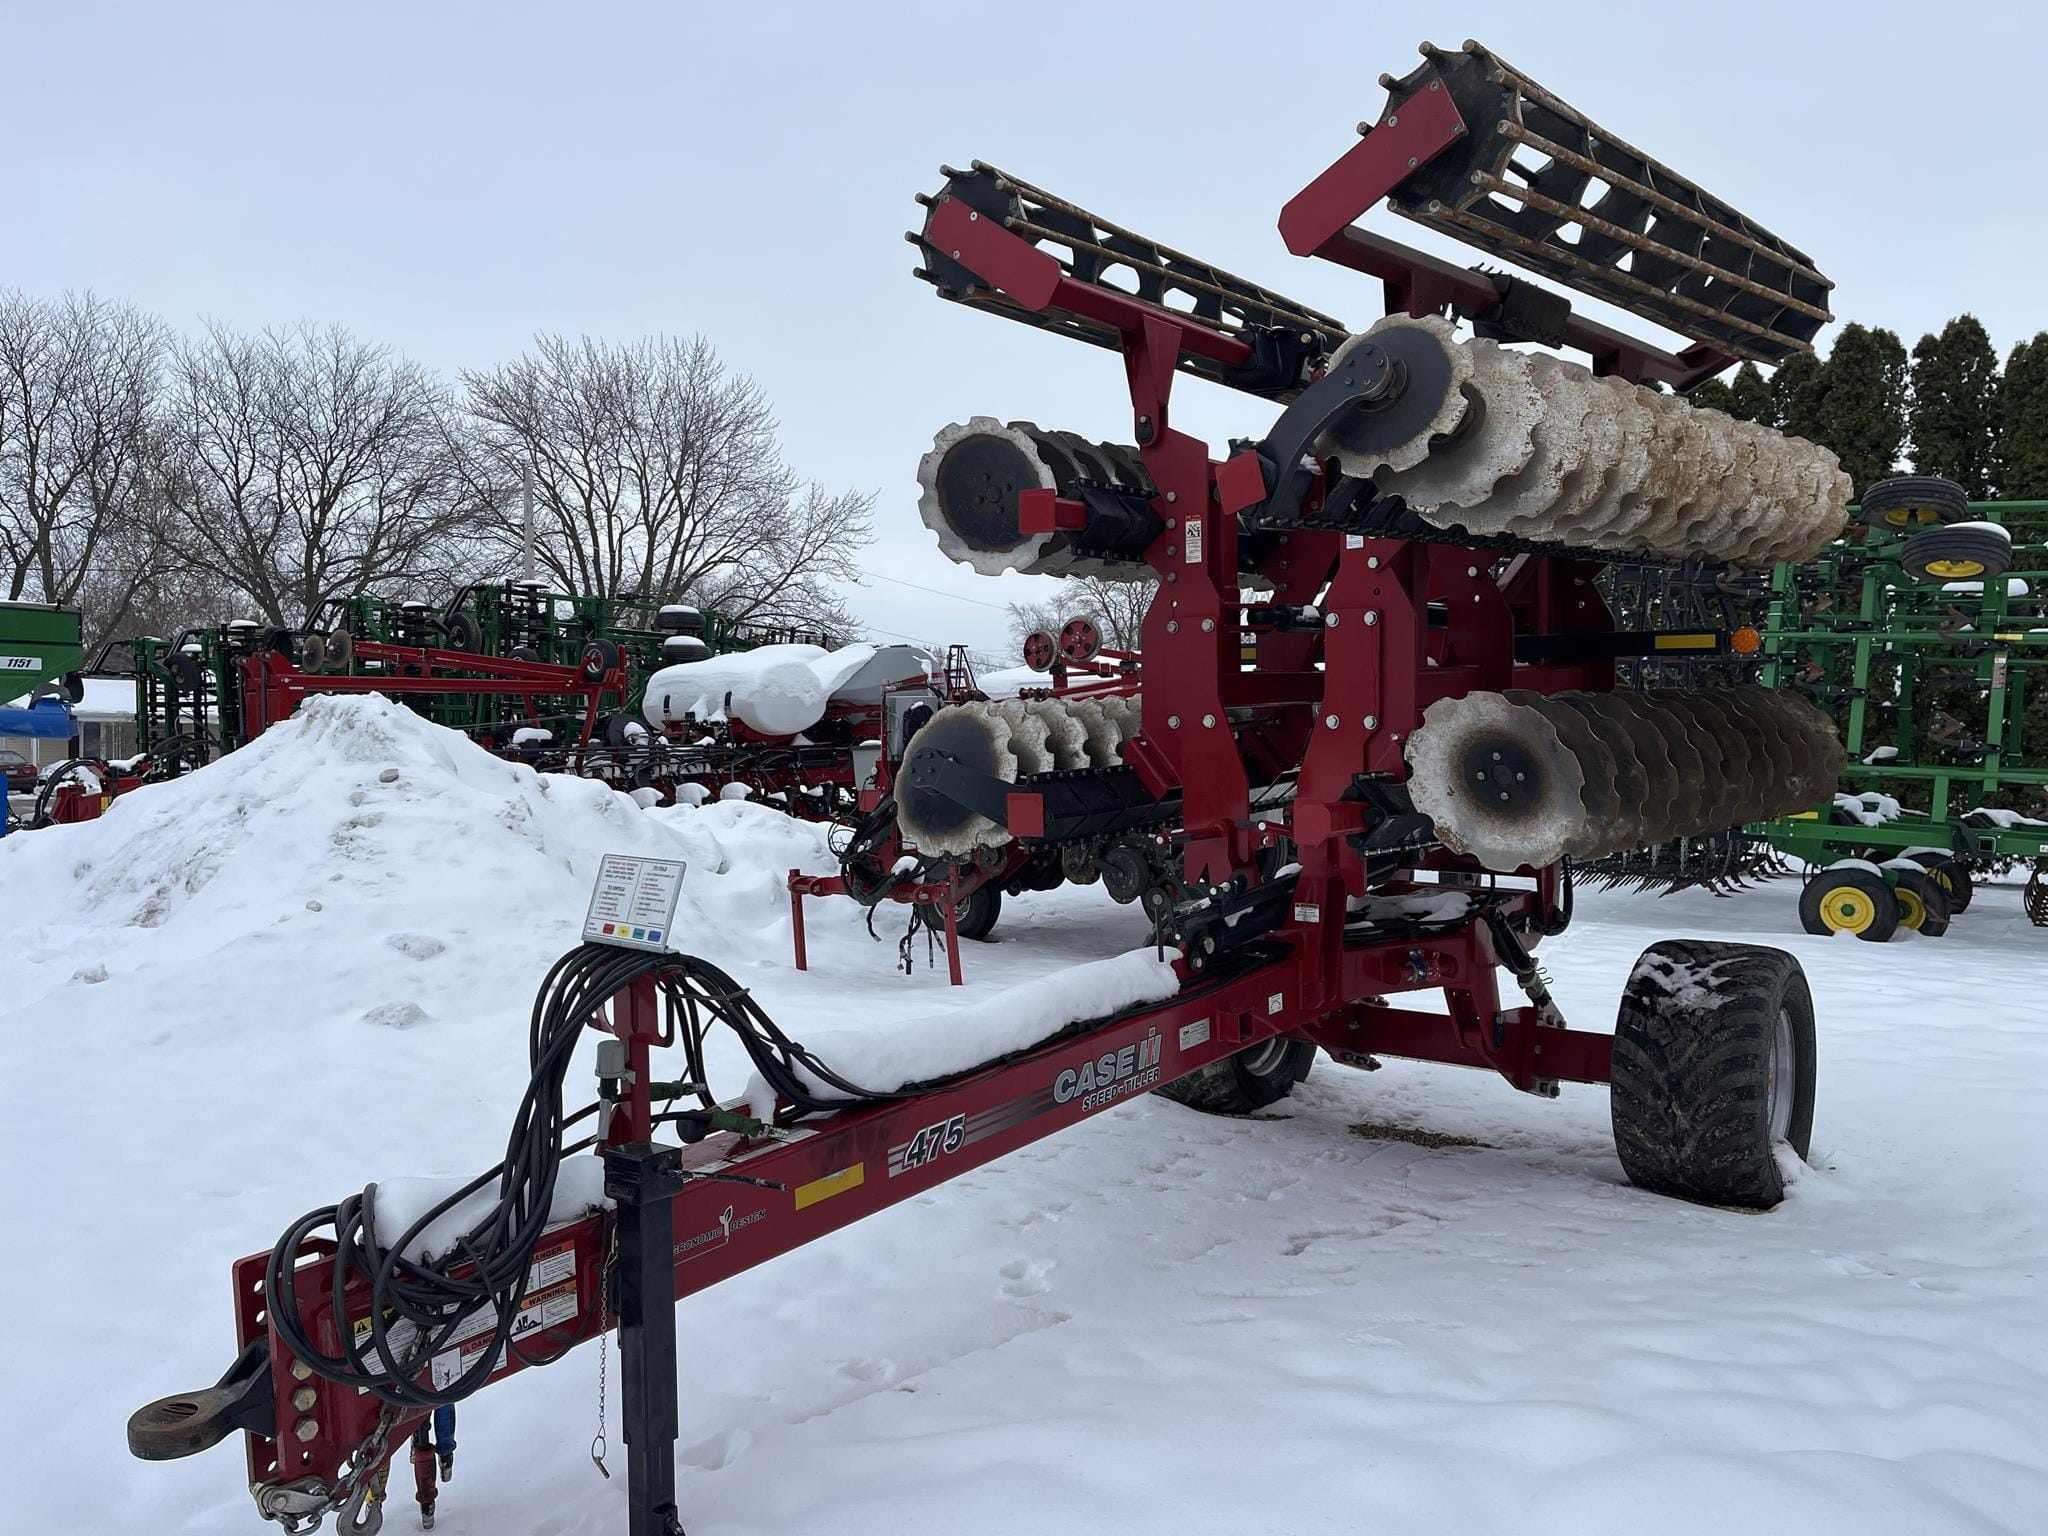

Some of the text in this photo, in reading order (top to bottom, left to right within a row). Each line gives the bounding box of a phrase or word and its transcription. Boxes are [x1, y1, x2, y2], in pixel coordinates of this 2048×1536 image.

[7, 658, 32, 668] 1151
[1053, 1045, 1135, 1104] CASE
[1082, 1067, 1160, 1112] SPEED-TILLER
[904, 1112, 965, 1169] 475
[672, 1209, 766, 1256] GRONOMIC DESIGN
[528, 1286, 566, 1306] WARNING
[471, 1335, 496, 1350] DANG
